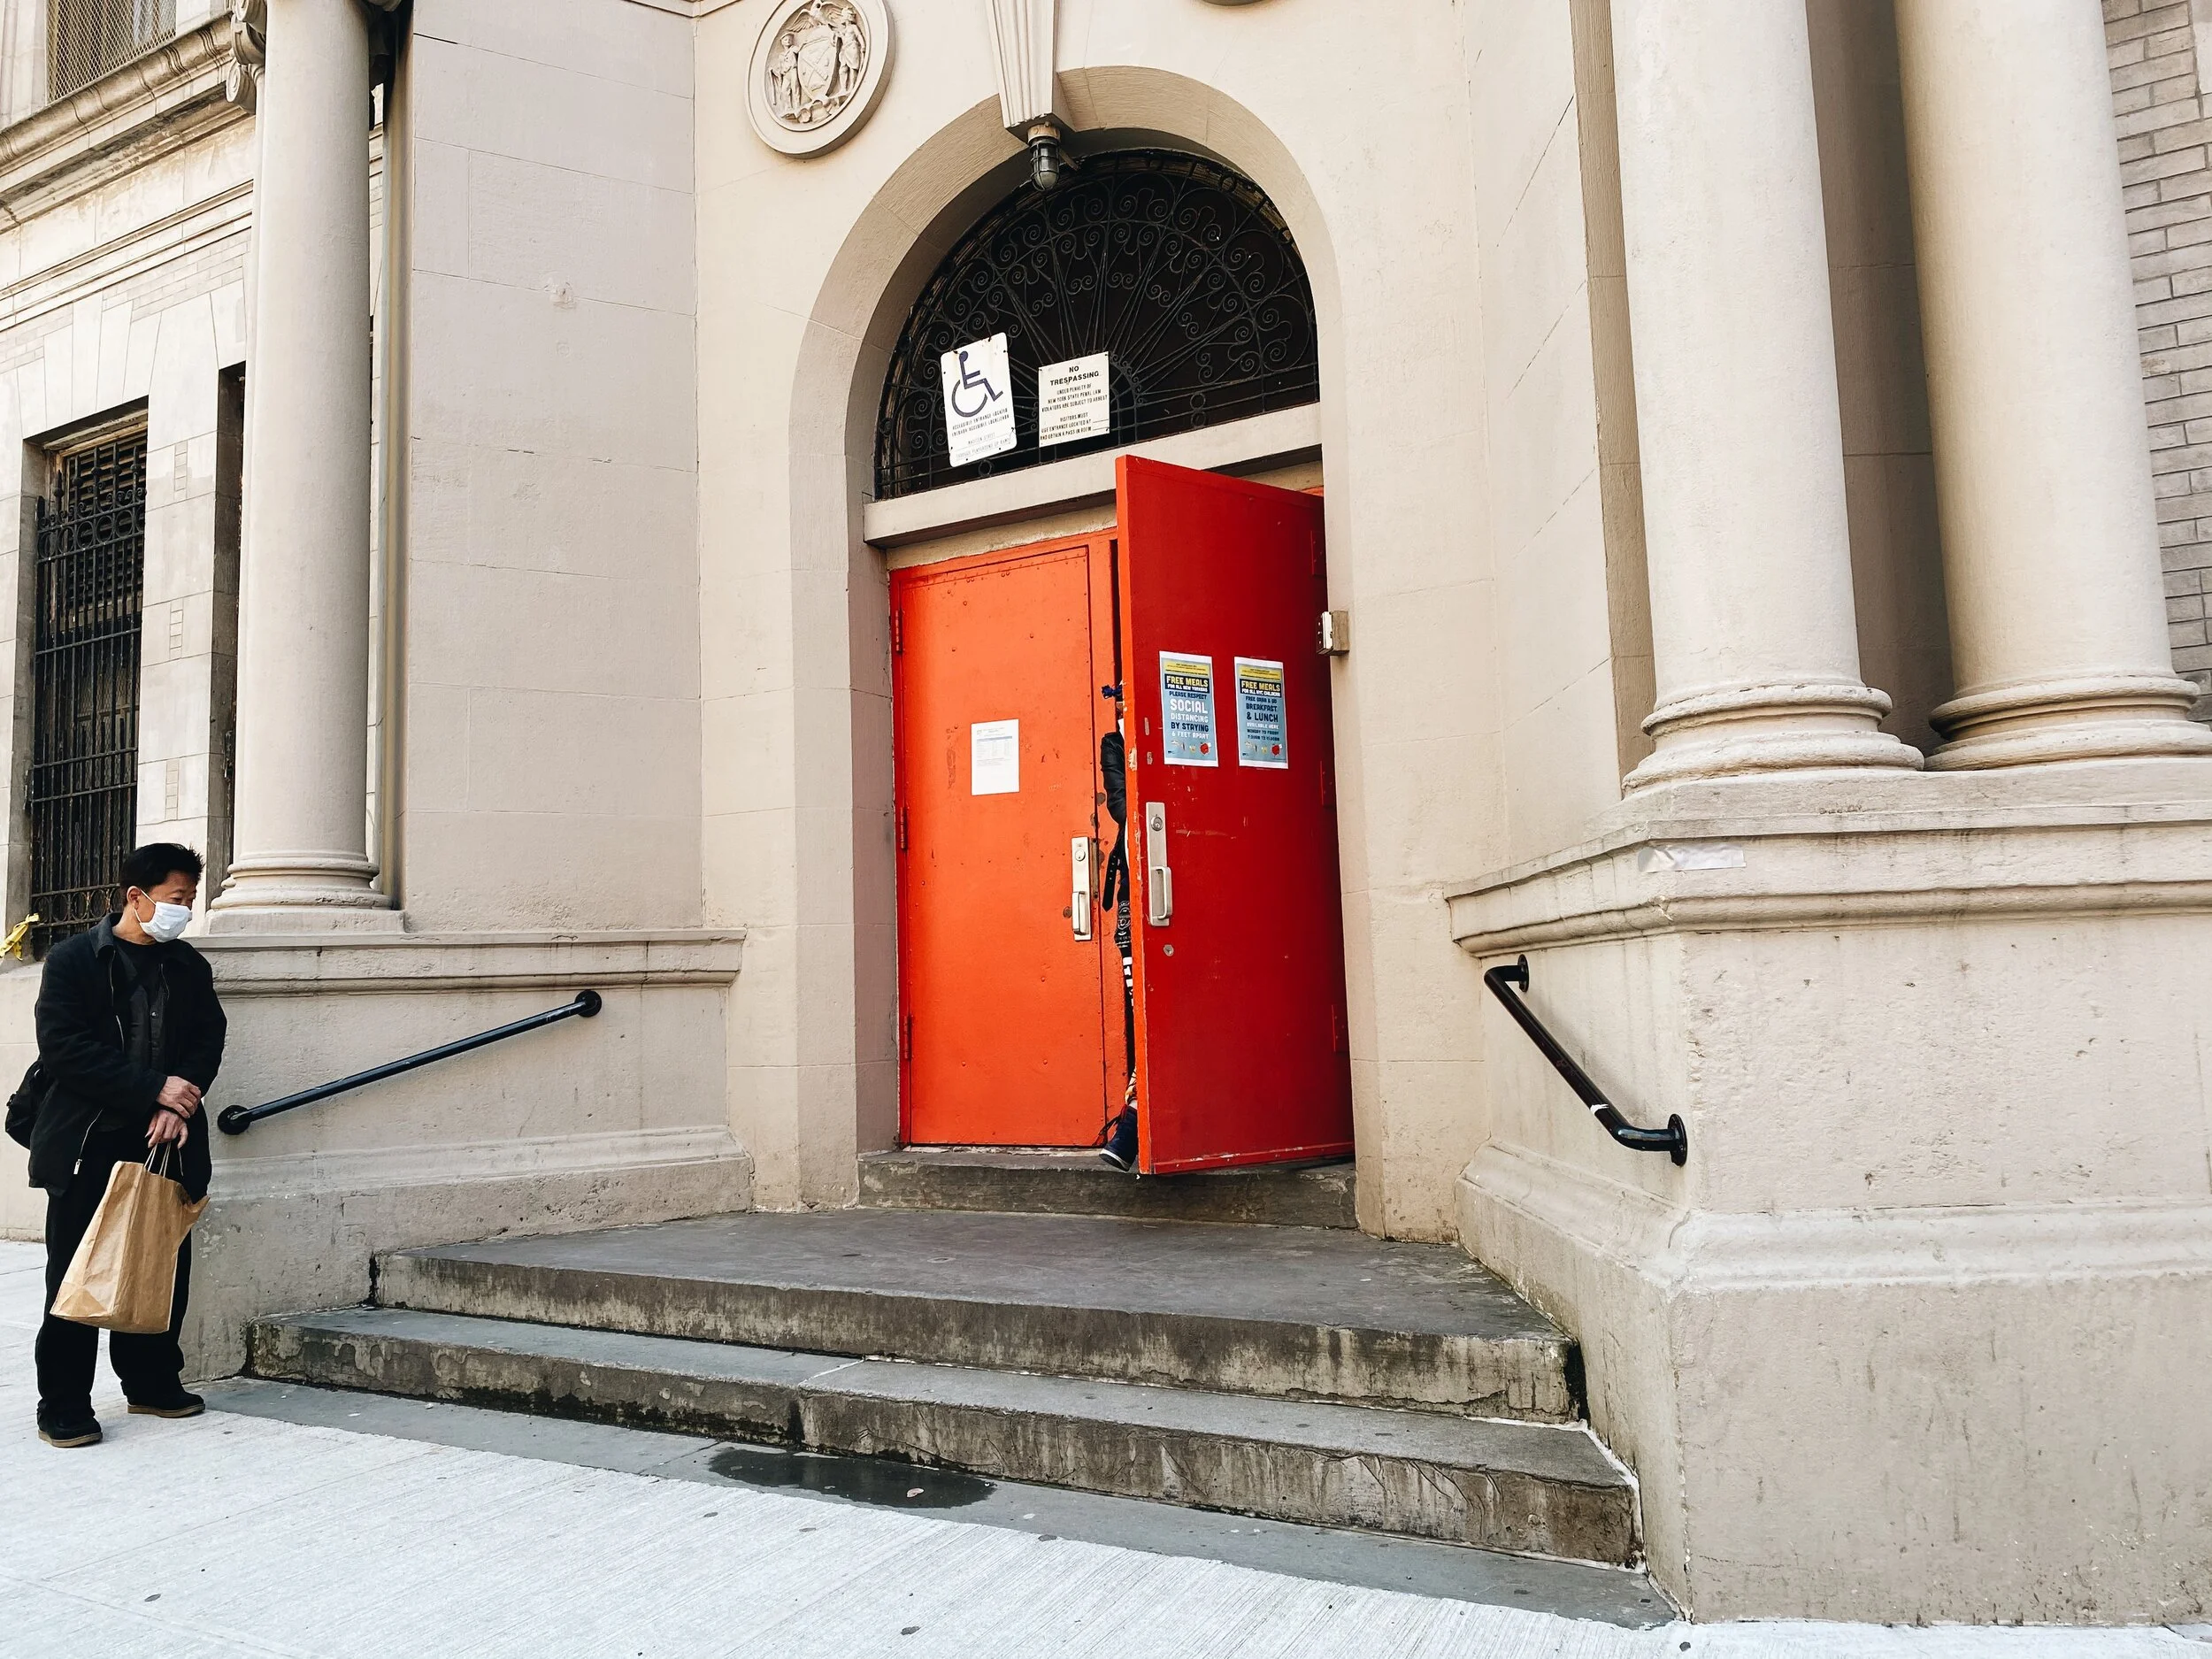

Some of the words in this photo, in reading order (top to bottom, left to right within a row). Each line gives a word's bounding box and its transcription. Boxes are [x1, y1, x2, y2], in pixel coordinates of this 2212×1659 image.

[1050, 371, 1099, 386] TRESPASSING
[1041, 403, 1061, 412] VIOLATORS
[1166, 675, 1184, 685] FREE
[1186, 678, 1209, 687] MEALS
[1241, 680, 1257, 689] FREE
[1258, 683, 1280, 692] MEALS
[1170, 698, 1208, 714] SOCIAL
[1171, 713, 1209, 723] DISTANCING
[1255, 712, 1279, 722] LUNCH
[1182, 723, 1209, 732] STAYING
